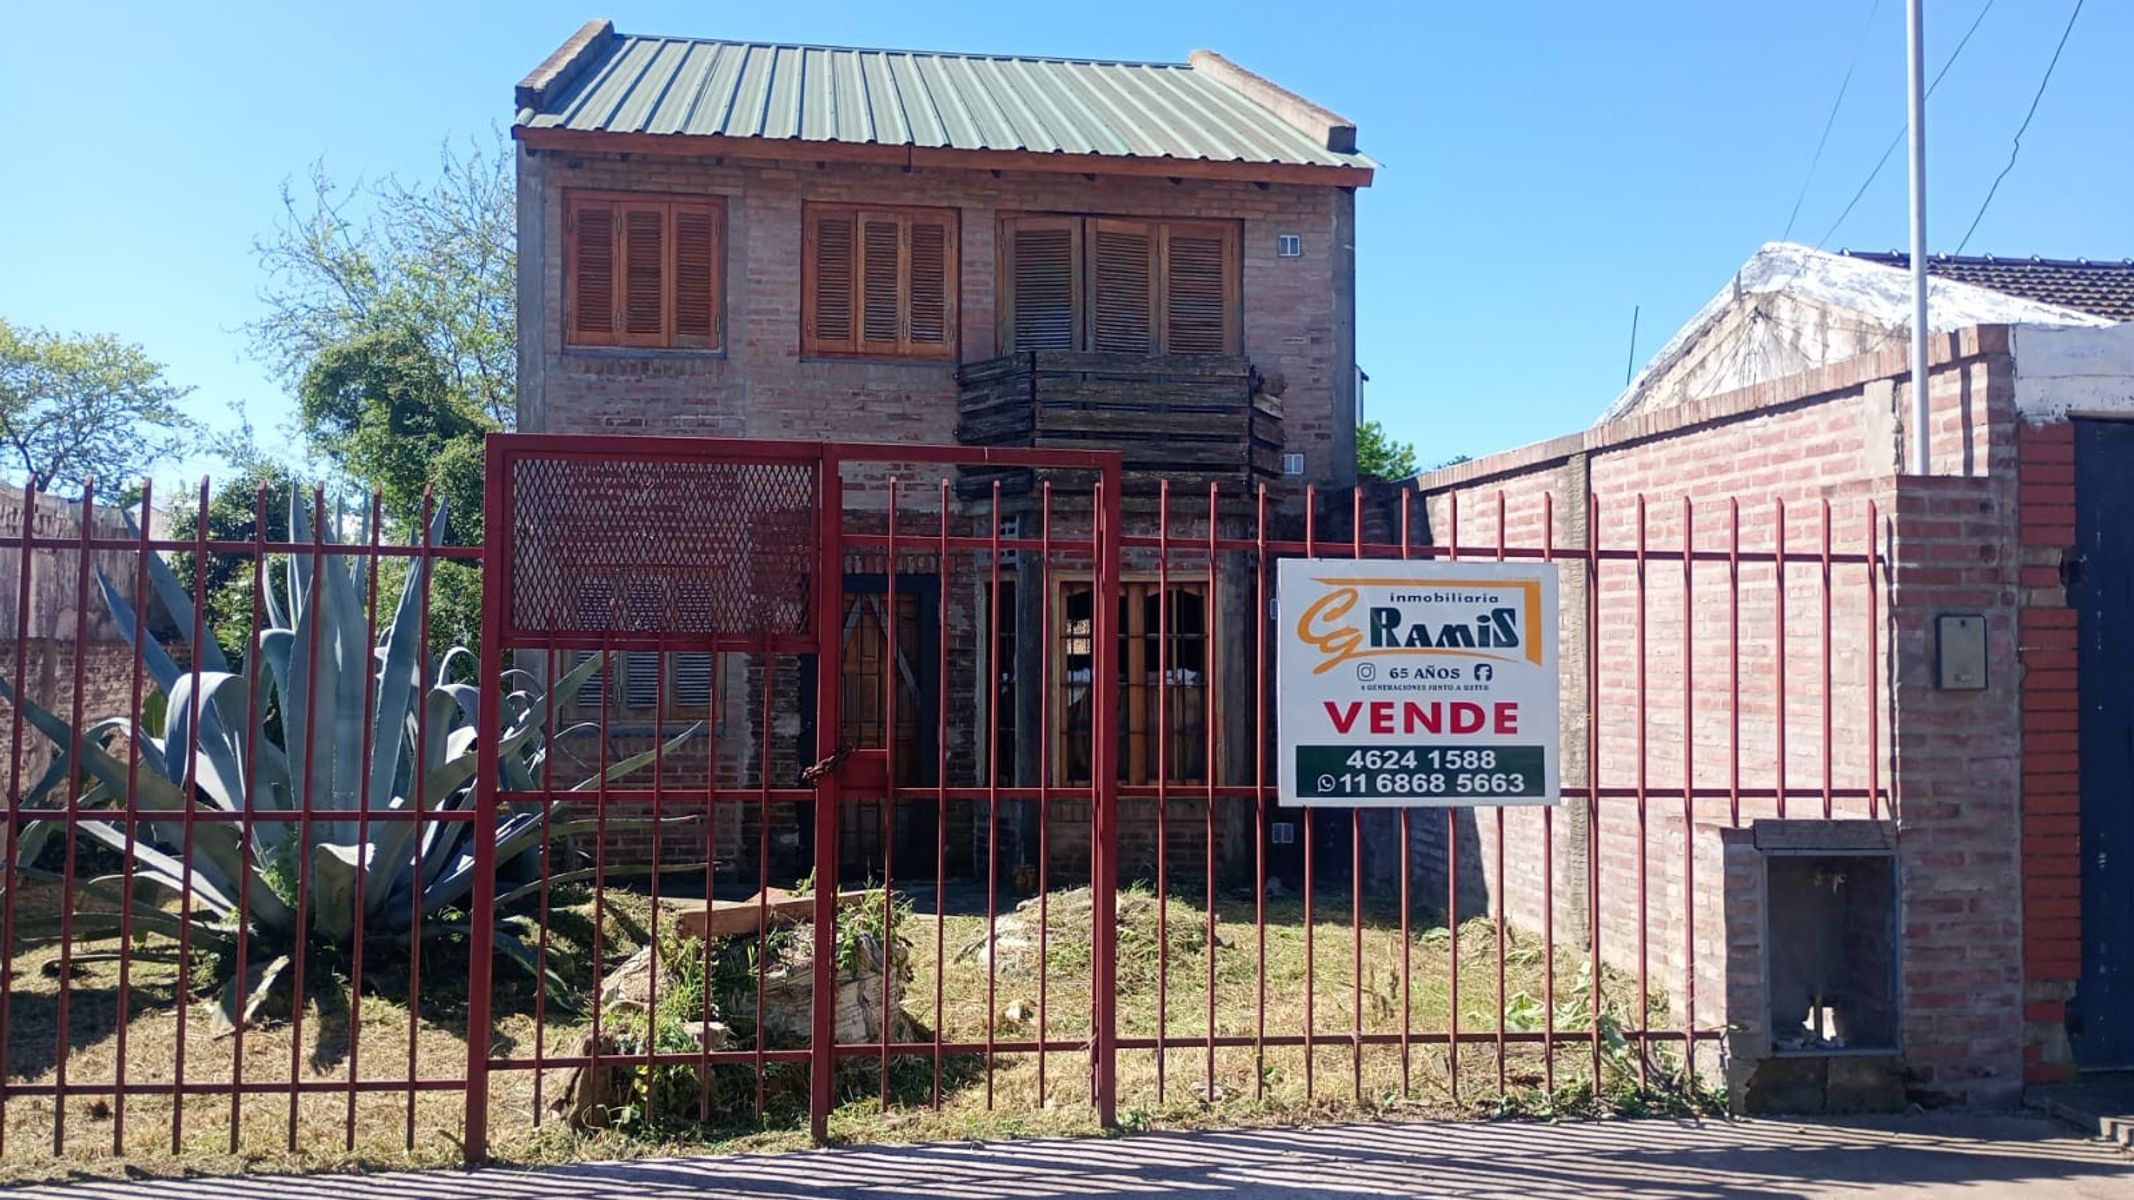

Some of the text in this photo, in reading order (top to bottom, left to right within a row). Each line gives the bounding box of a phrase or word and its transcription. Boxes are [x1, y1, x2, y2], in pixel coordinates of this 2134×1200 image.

[1389, 592, 1499, 604] inmobiliaria
[1389, 665, 1461, 680] 65 AÑOS
[1455, 684, 1462, 692] A
[1322, 701, 1518, 734] VENDE
[1345, 749, 1497, 769] 4624 1588
[1339, 773, 1525, 793] 11 6868 5663
